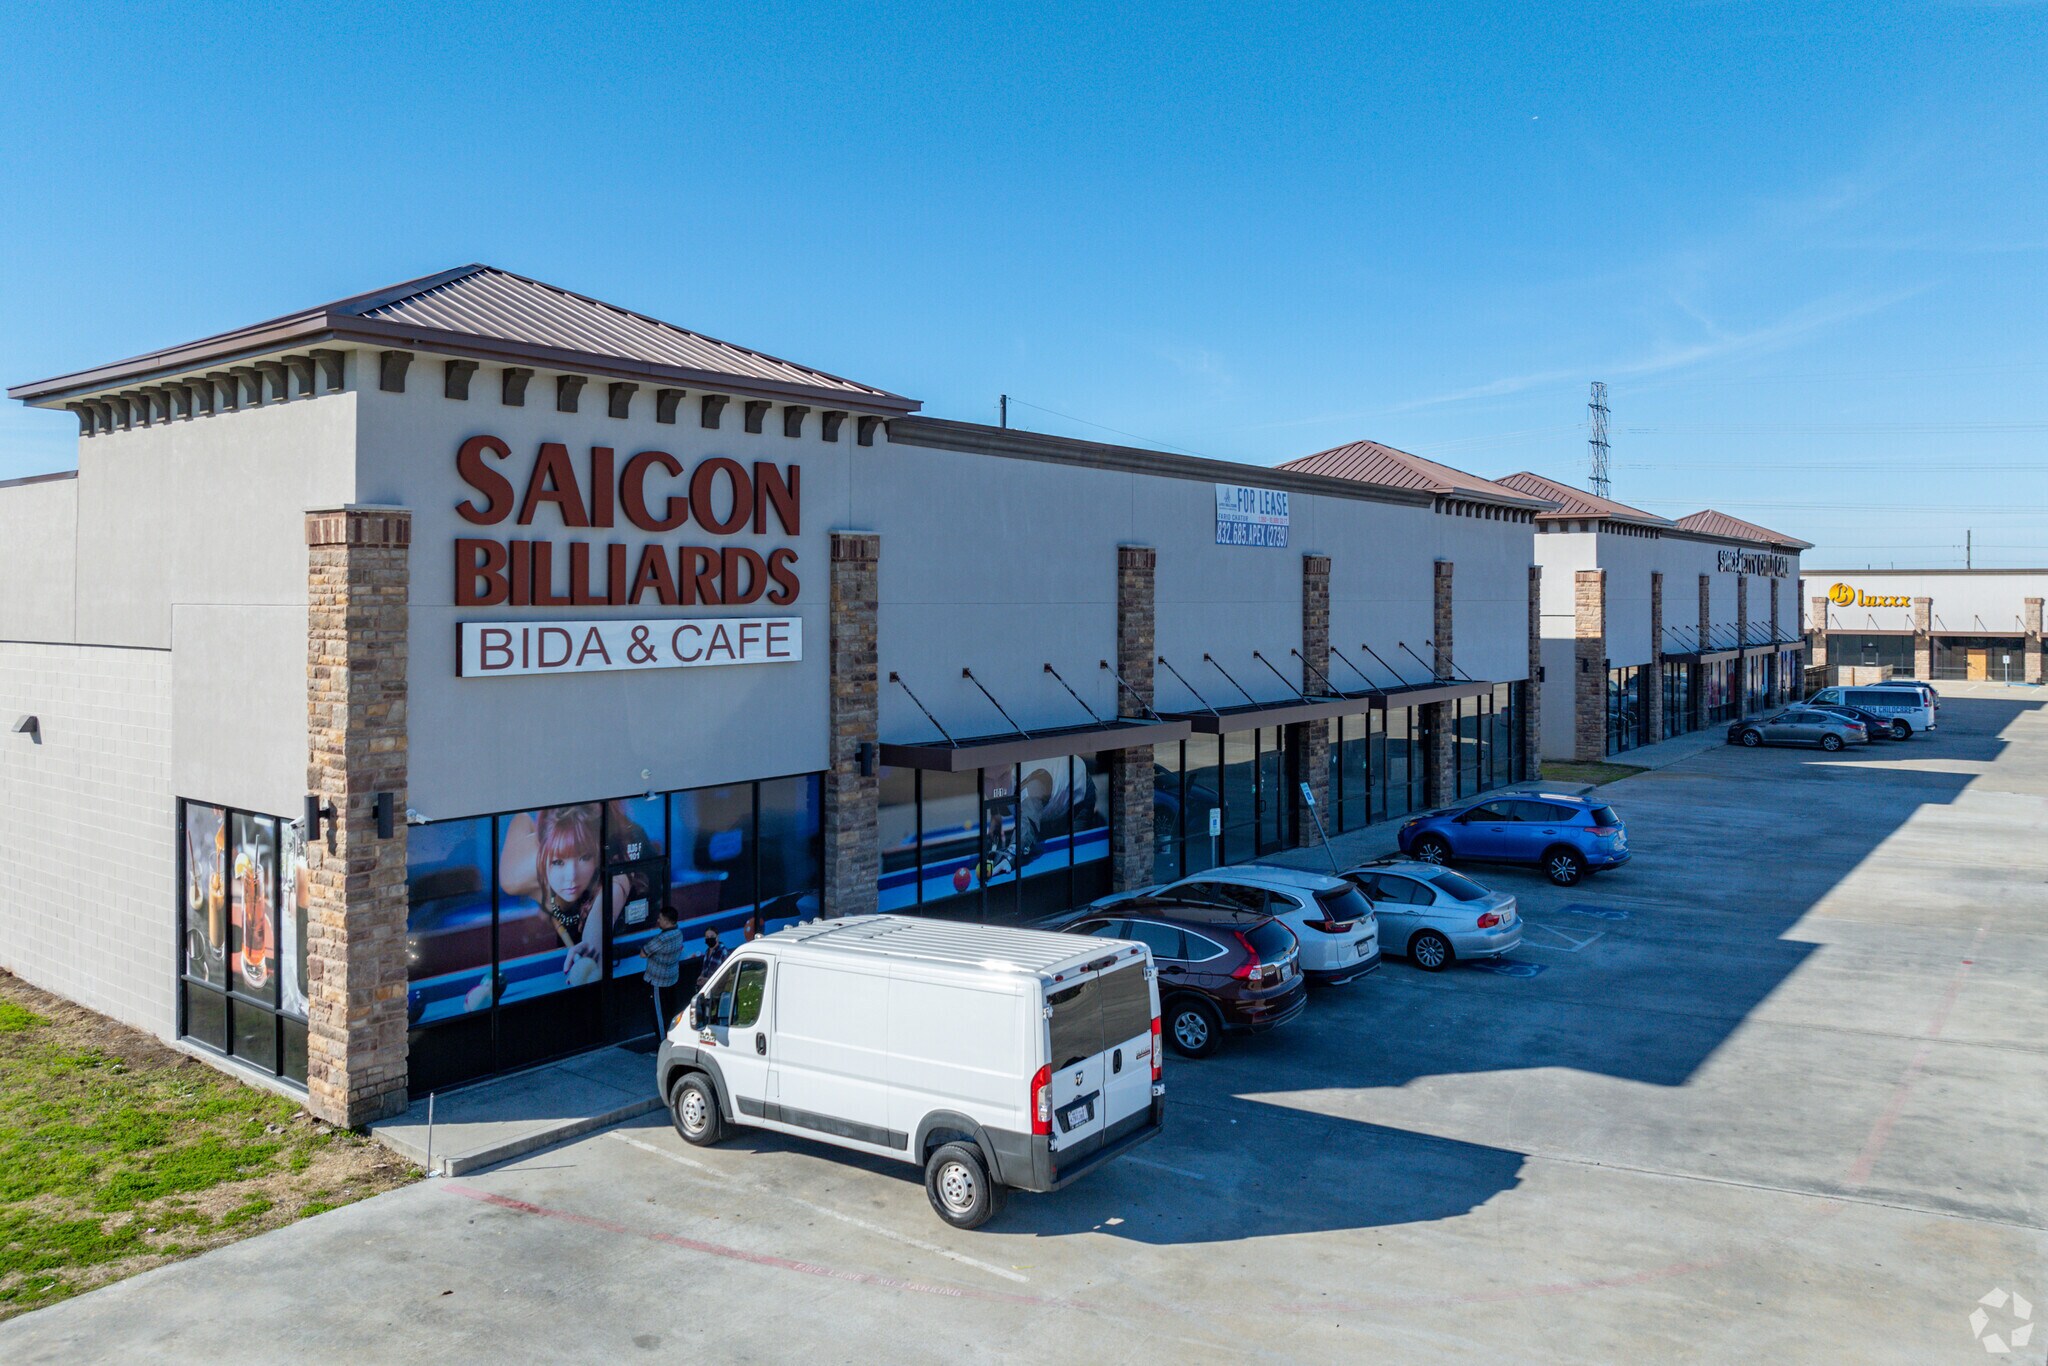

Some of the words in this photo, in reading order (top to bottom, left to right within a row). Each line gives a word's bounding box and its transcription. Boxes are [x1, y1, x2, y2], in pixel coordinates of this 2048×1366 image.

[455, 435, 800, 536] SAIGON
[1237, 487, 1255, 514] FOR
[1259, 490, 1288, 516] LEASE
[455, 538, 800, 606] BILLIARDS
[1858, 589, 1911, 608] luxxx
[480, 627, 612, 671] BIDA
[626, 625, 658, 664] &
[671, 622, 791, 663] CAFE
[794, 1263, 825, 1275] FIRE
